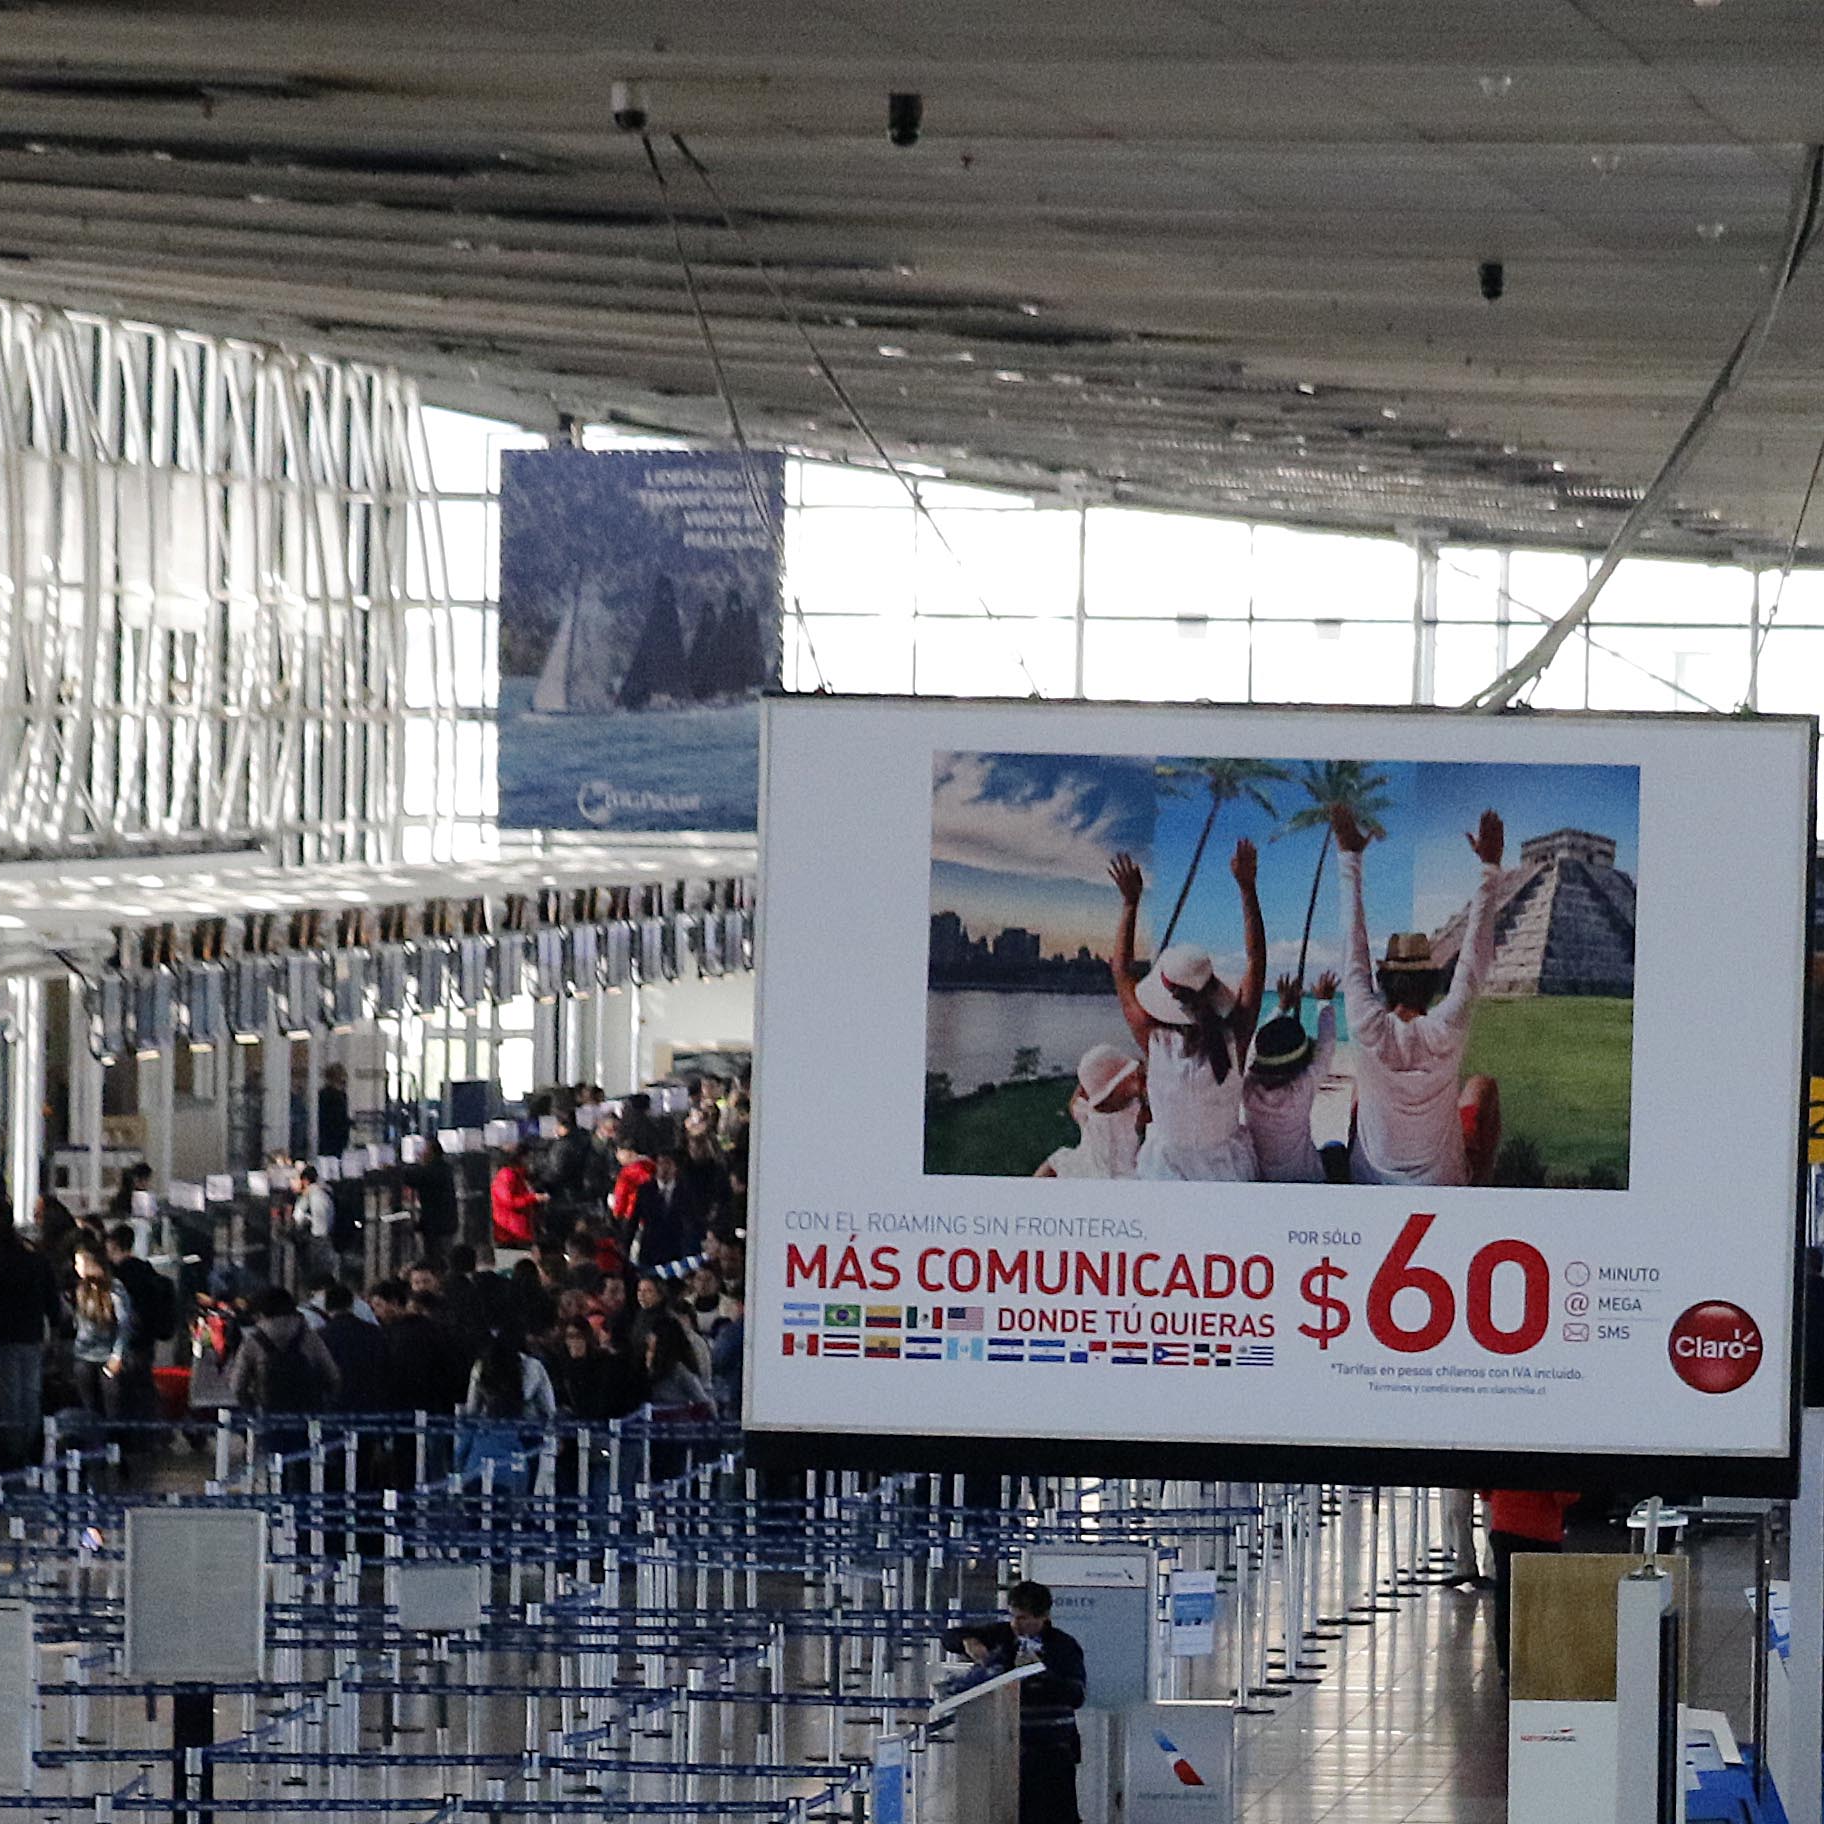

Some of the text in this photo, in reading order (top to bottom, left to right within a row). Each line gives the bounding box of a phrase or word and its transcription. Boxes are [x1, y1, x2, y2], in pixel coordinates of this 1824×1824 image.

[784, 1211, 832, 1232] CON
[836, 1212, 861, 1232] EL
[867, 1212, 968, 1236] ROAMING
[973, 1215, 1009, 1236] SIN
[1288, 1227, 1362, 1246] POR SÓLO
[784, 1233, 1275, 1300] MÁS COMUNICADO
[1598, 1266, 1661, 1283] MINUTO
[1598, 1297, 1643, 1312] MEGA
[997, 1303, 1275, 1338] DONDE TÚ QUIERAS
[1597, 1324, 1631, 1340] SMS
[1675, 1332, 1750, 1359] Claro
[1380, 1366, 1395, 1376] en
[1397, 1367, 1433, 1379] pesos
[1436, 1366, 1486, 1378] chilenos
[1488, 1368, 1509, 1378] con
[1512, 1367, 1532, 1379] IVA
